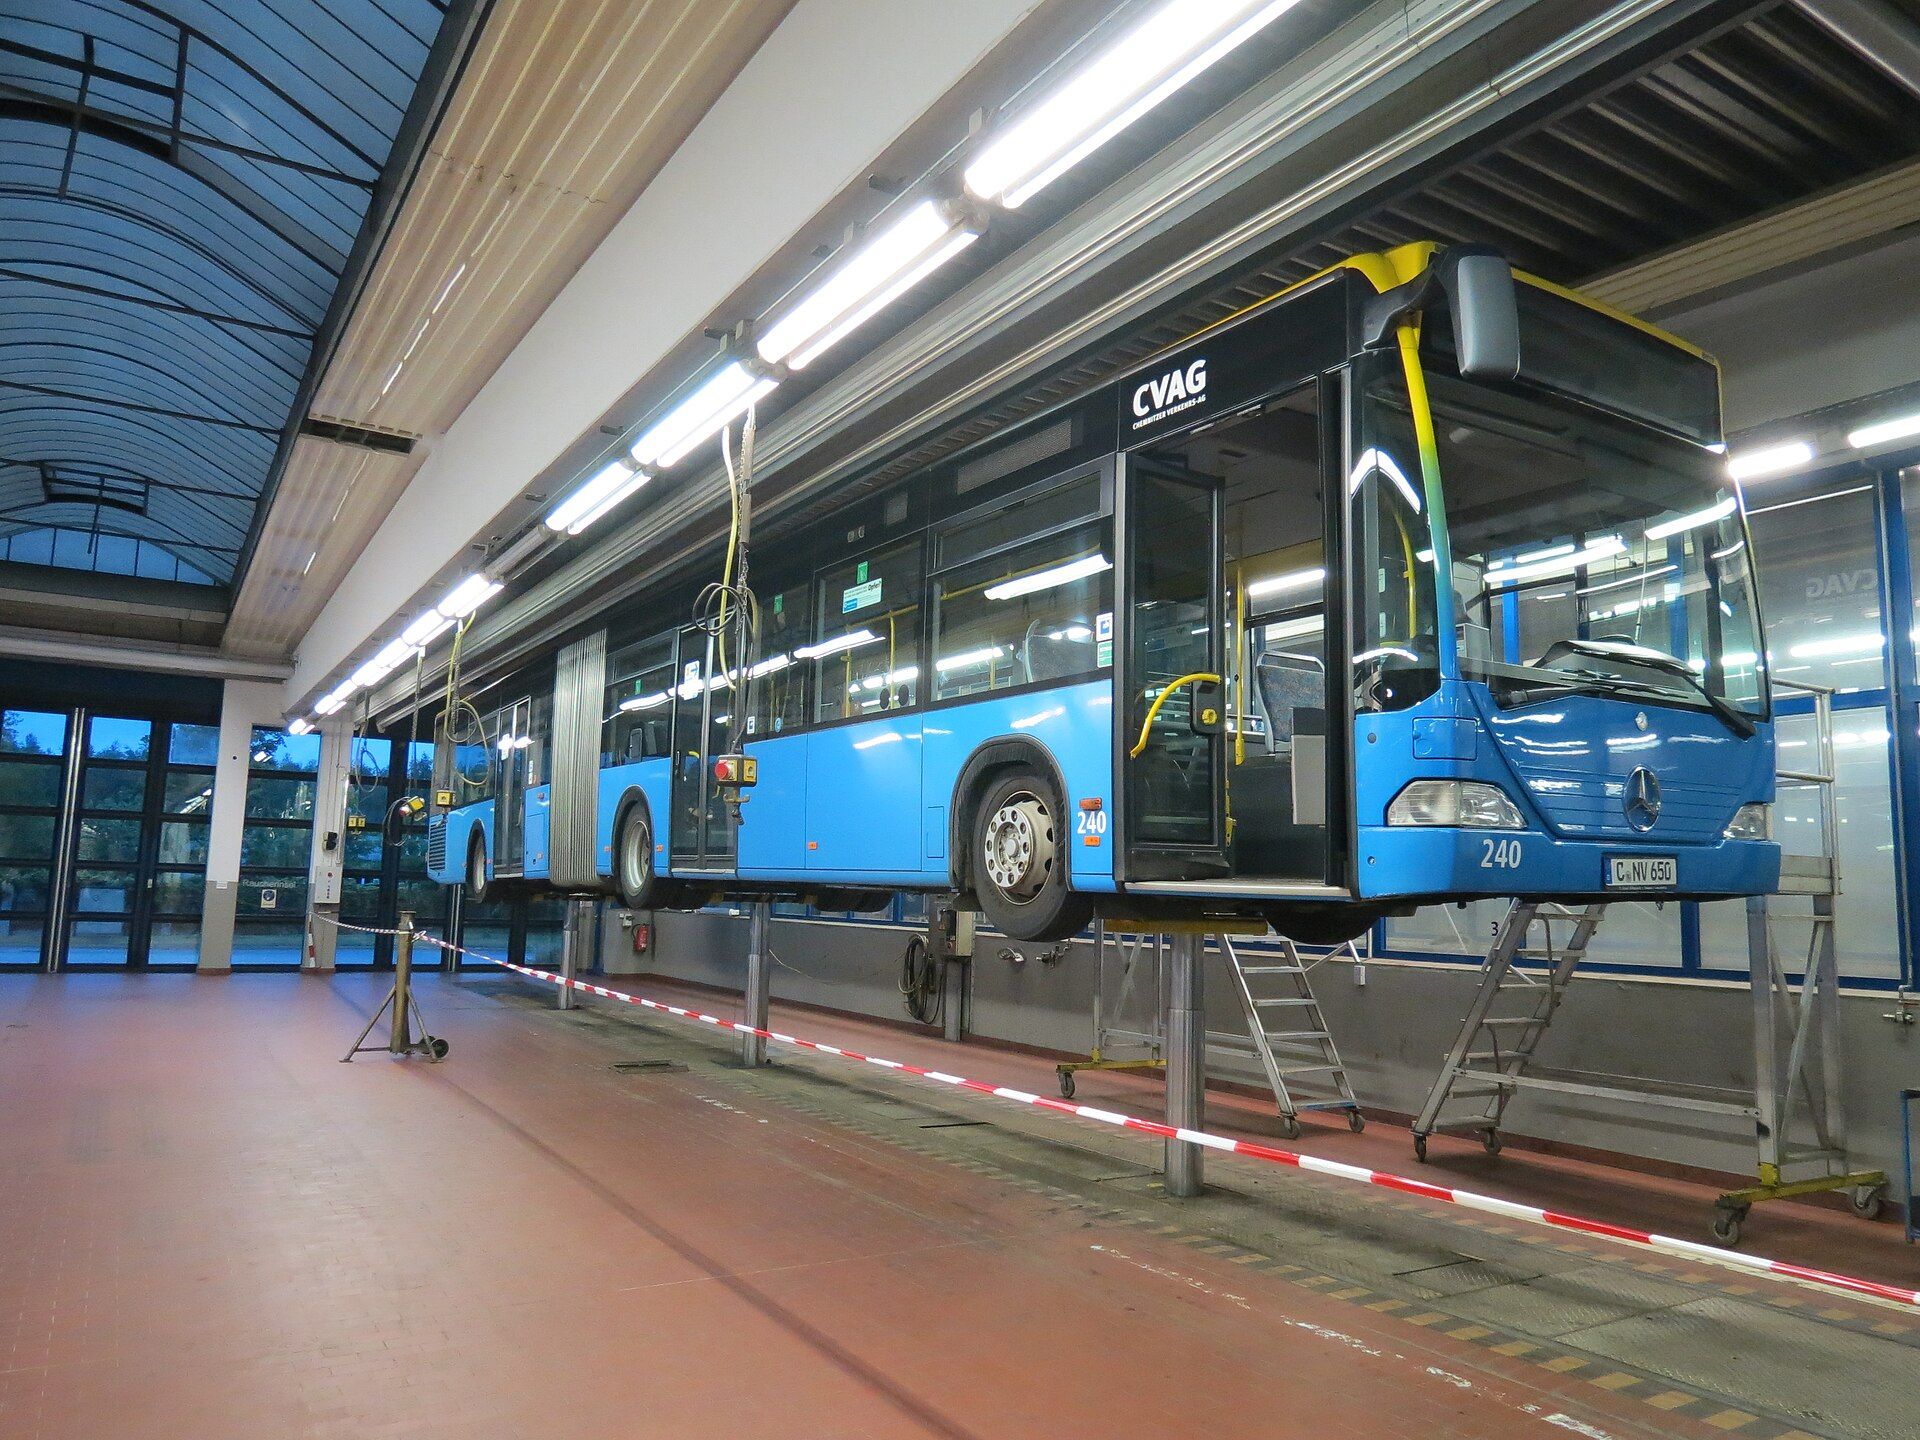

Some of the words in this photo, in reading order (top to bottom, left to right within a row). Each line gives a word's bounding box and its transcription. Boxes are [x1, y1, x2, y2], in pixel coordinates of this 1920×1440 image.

[1133, 359, 1207, 417] CVAG
[1077, 811, 1107, 834] 240
[1480, 839, 1522, 869] 240
[1616, 861, 1625, 882] C
[1632, 861, 1648, 882] NV
[1650, 861, 1672, 881] 650
[1490, 921, 1499, 936] 3
